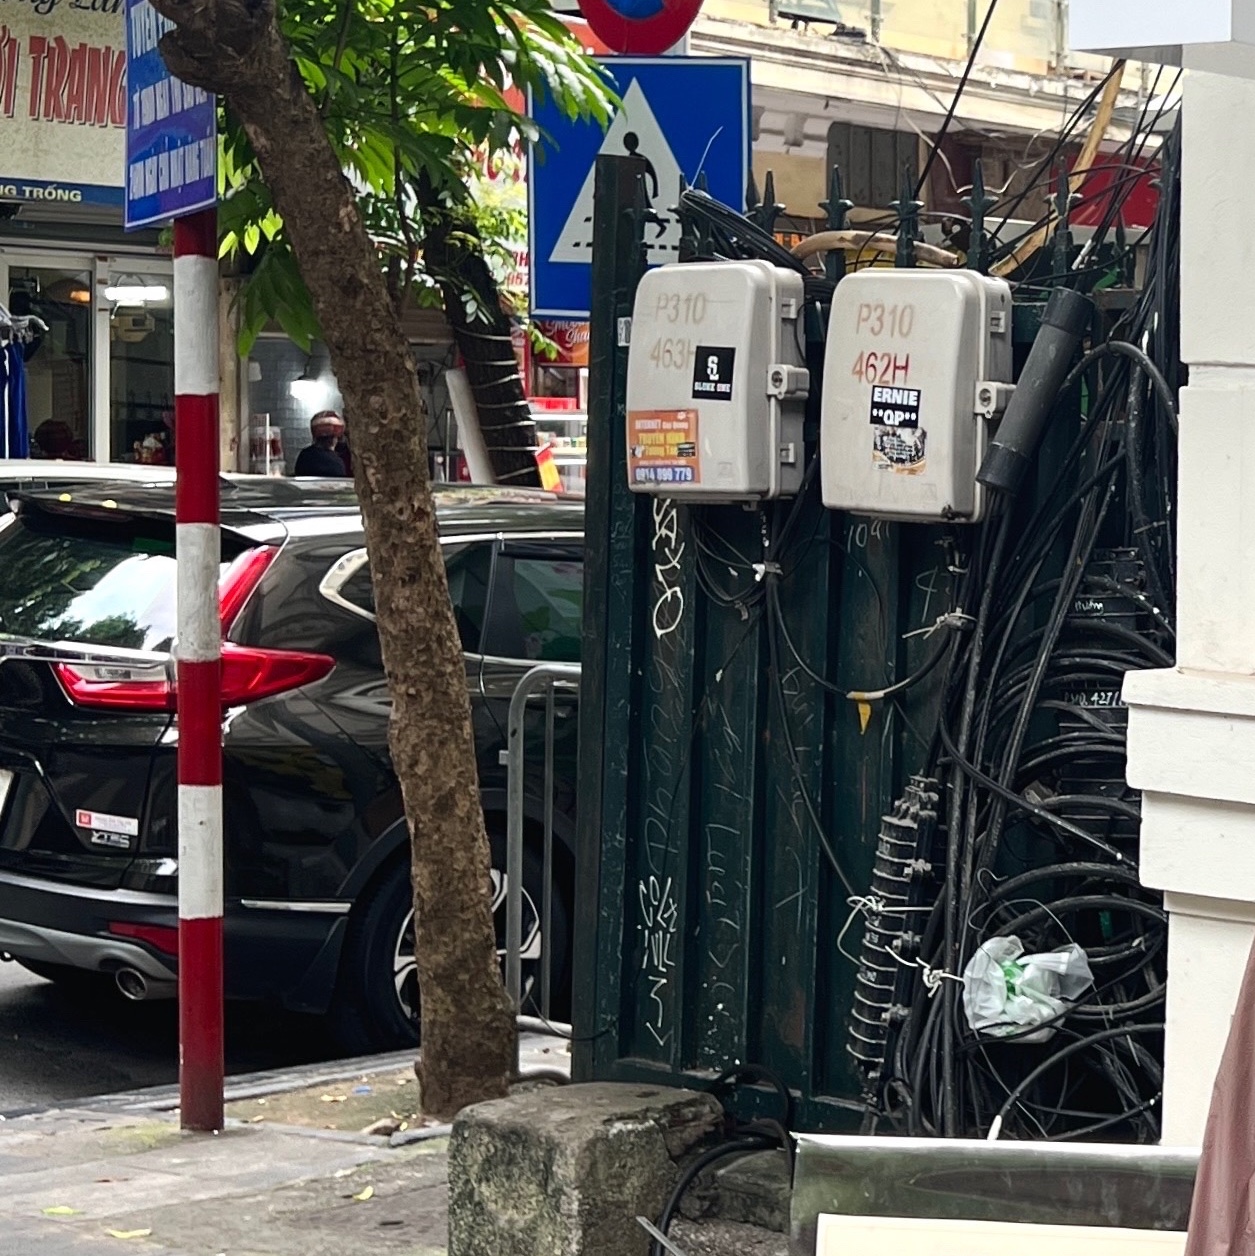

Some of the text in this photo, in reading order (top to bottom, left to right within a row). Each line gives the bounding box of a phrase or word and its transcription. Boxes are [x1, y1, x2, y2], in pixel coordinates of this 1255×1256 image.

[22, 184, 82, 202] TRỐNG
[655, 292, 706, 326] P310
[856, 303, 915, 339] P310
[852, 350, 910, 386] 462H
[873, 387, 918, 407] ERNIE
